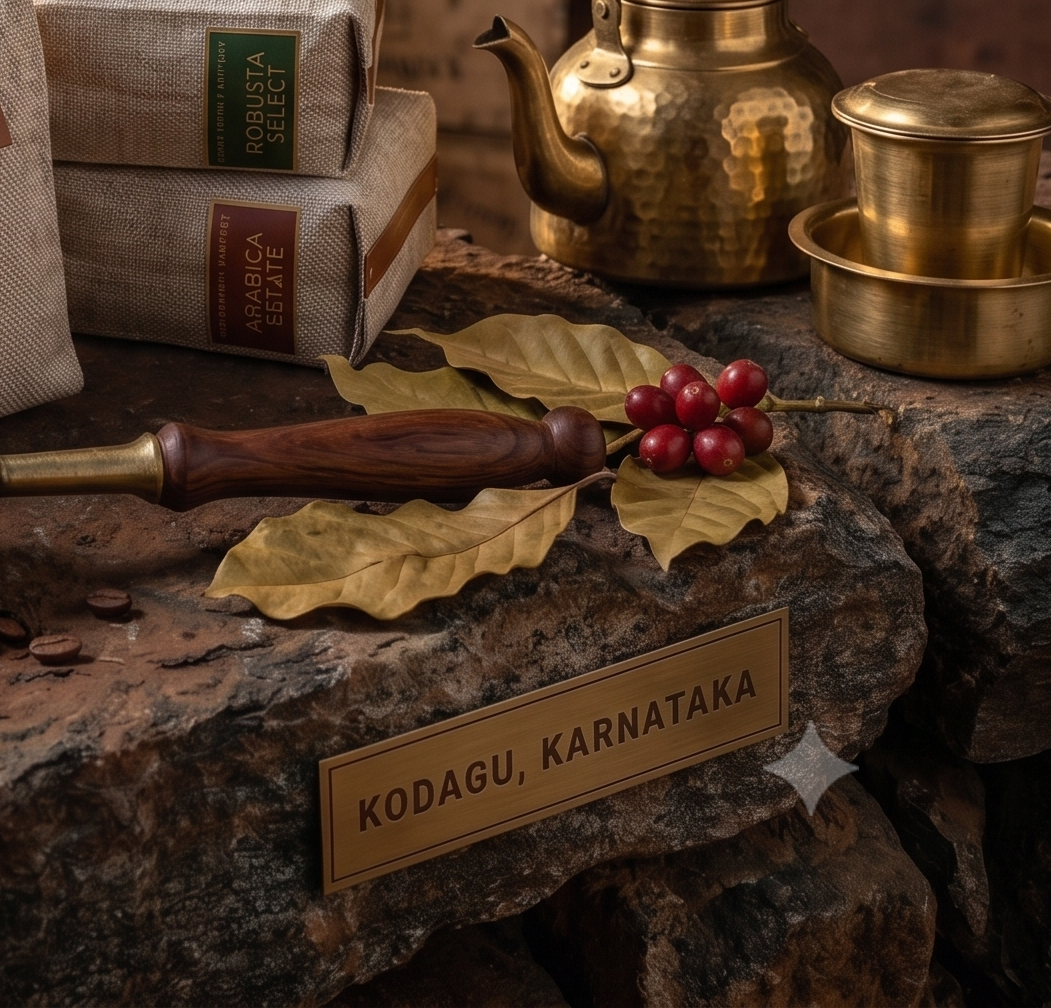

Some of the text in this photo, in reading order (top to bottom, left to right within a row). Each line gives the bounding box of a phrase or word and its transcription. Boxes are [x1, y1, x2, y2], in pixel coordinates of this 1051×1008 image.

[245, 51, 265, 155] ROBUSTA
[266, 64, 286, 144] SELECT
[244, 232, 264, 334] ARABICA
[357, 668, 758, 833] KODAGU, KARNATAKA
